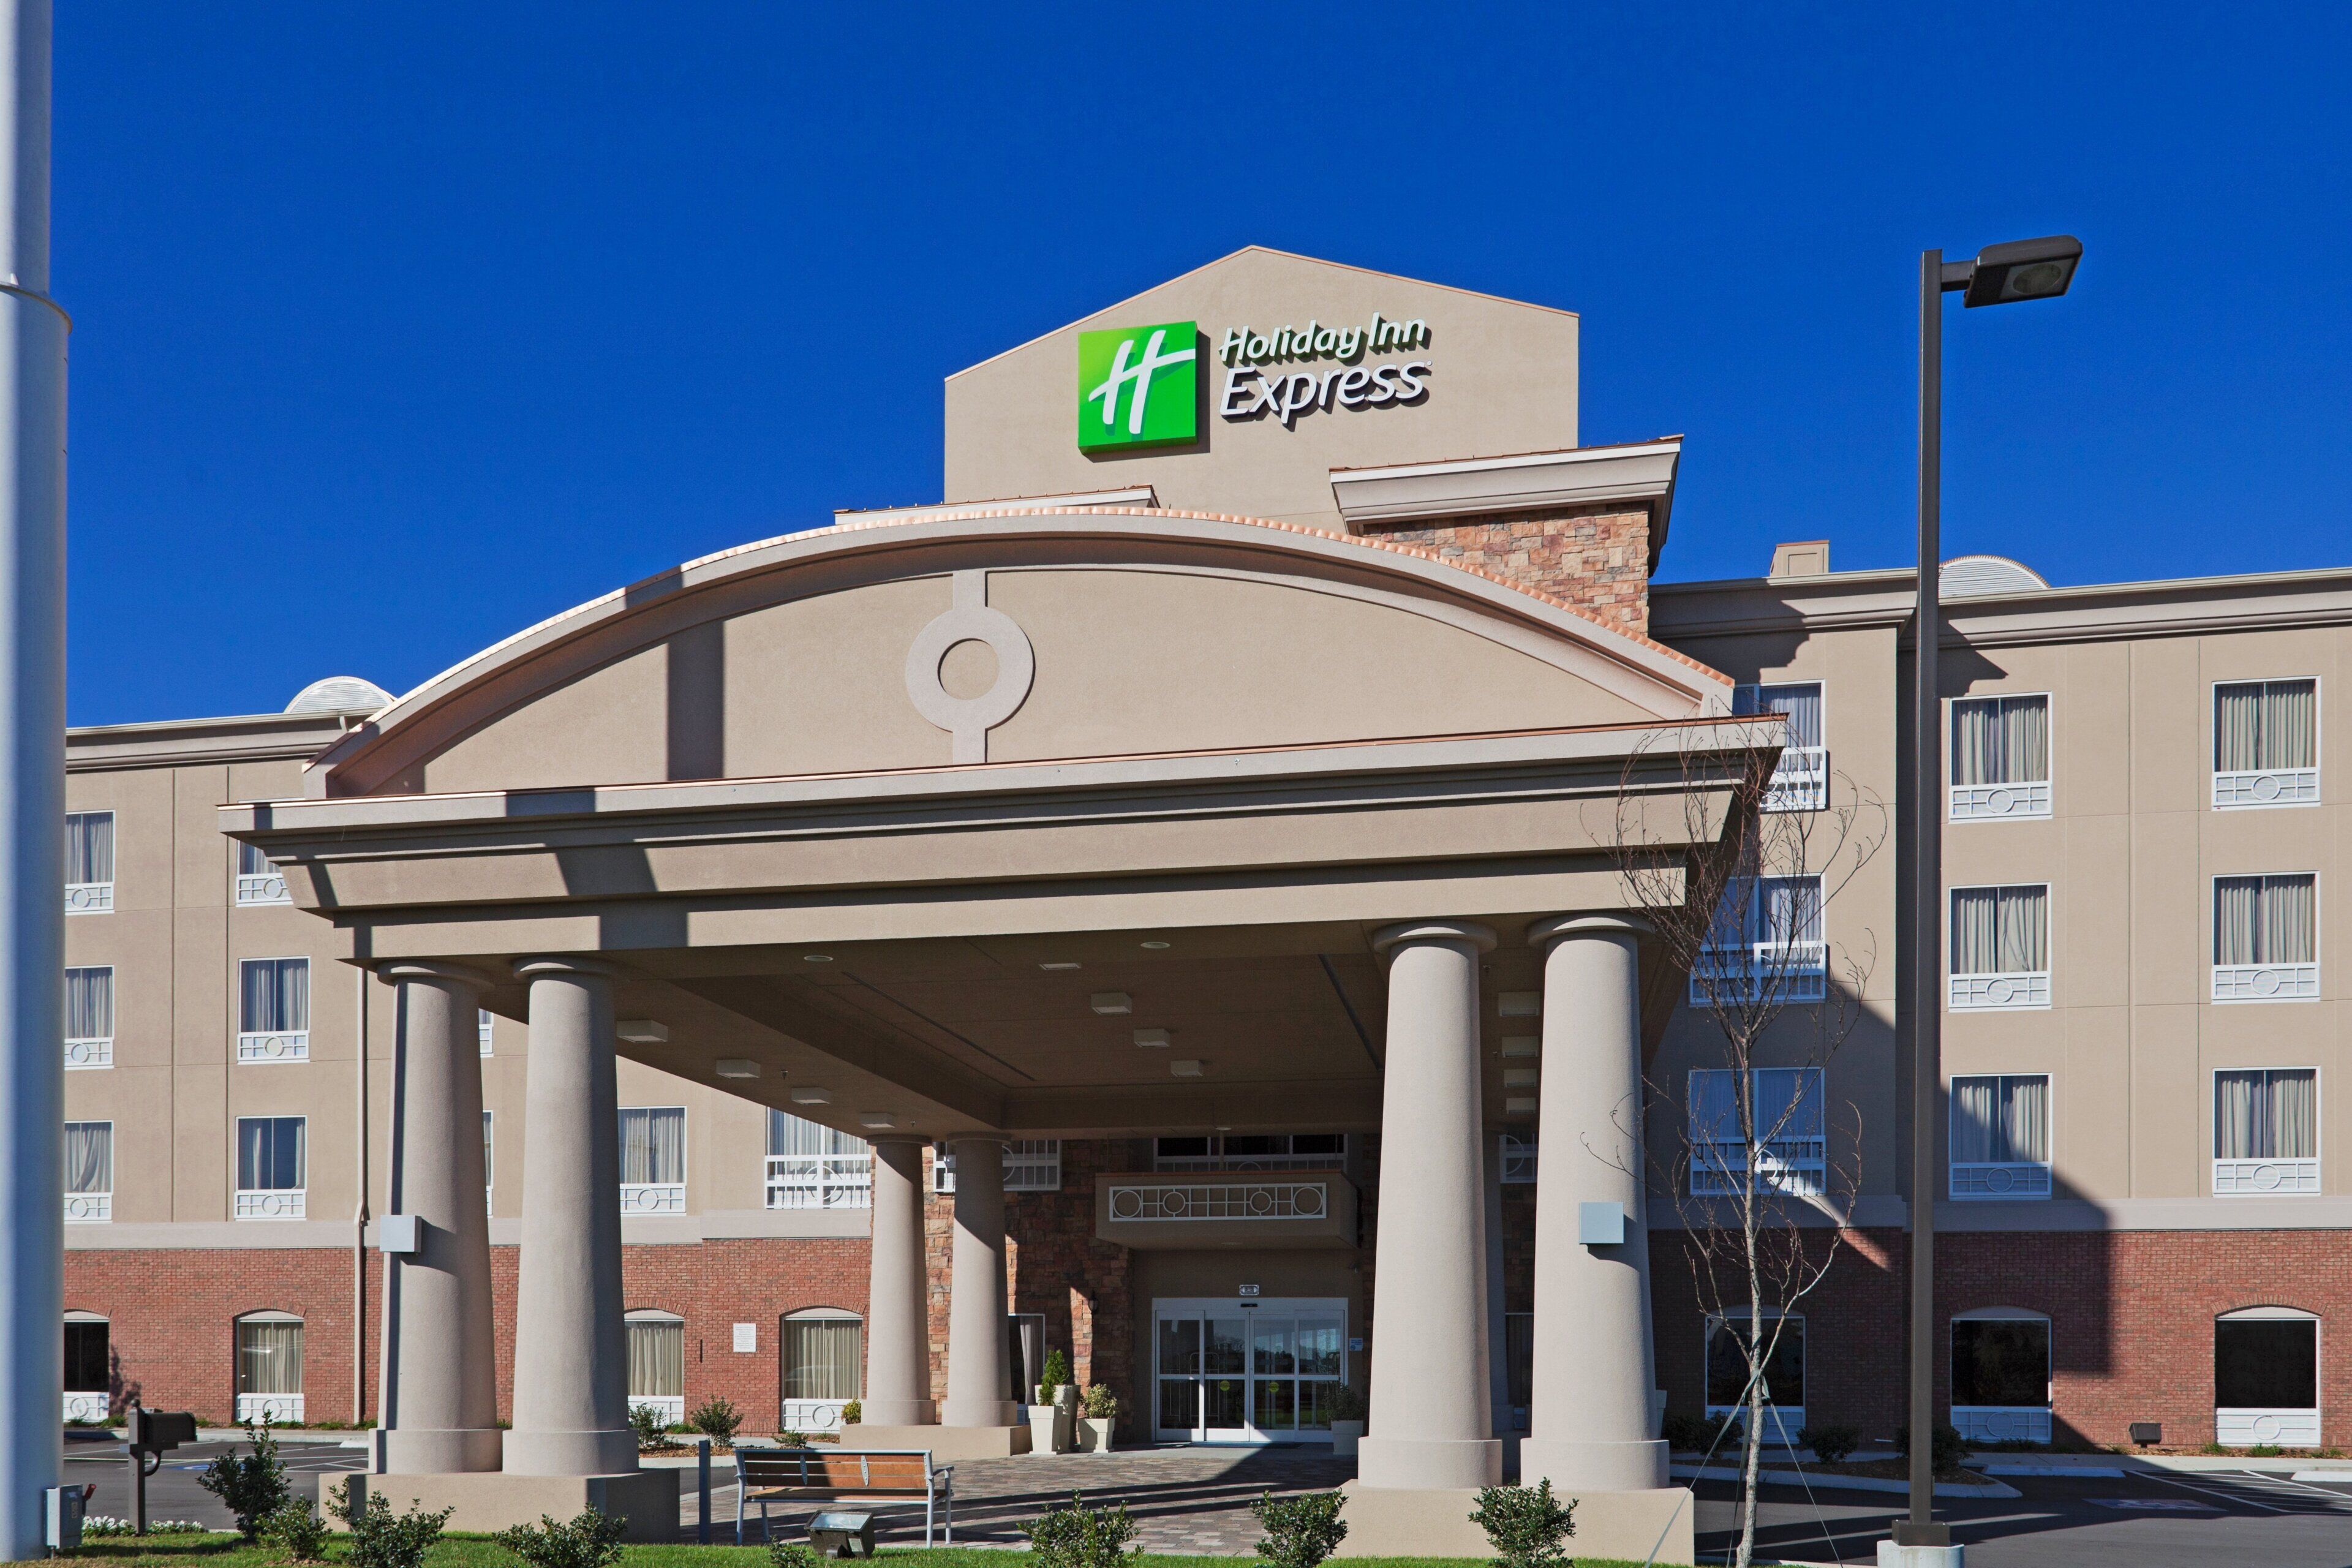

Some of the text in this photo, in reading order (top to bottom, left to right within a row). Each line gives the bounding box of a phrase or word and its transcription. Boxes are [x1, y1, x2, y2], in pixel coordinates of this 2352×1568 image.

[1218, 311, 1426, 362] Holiday Inn
[1219, 360, 1425, 424] Express
